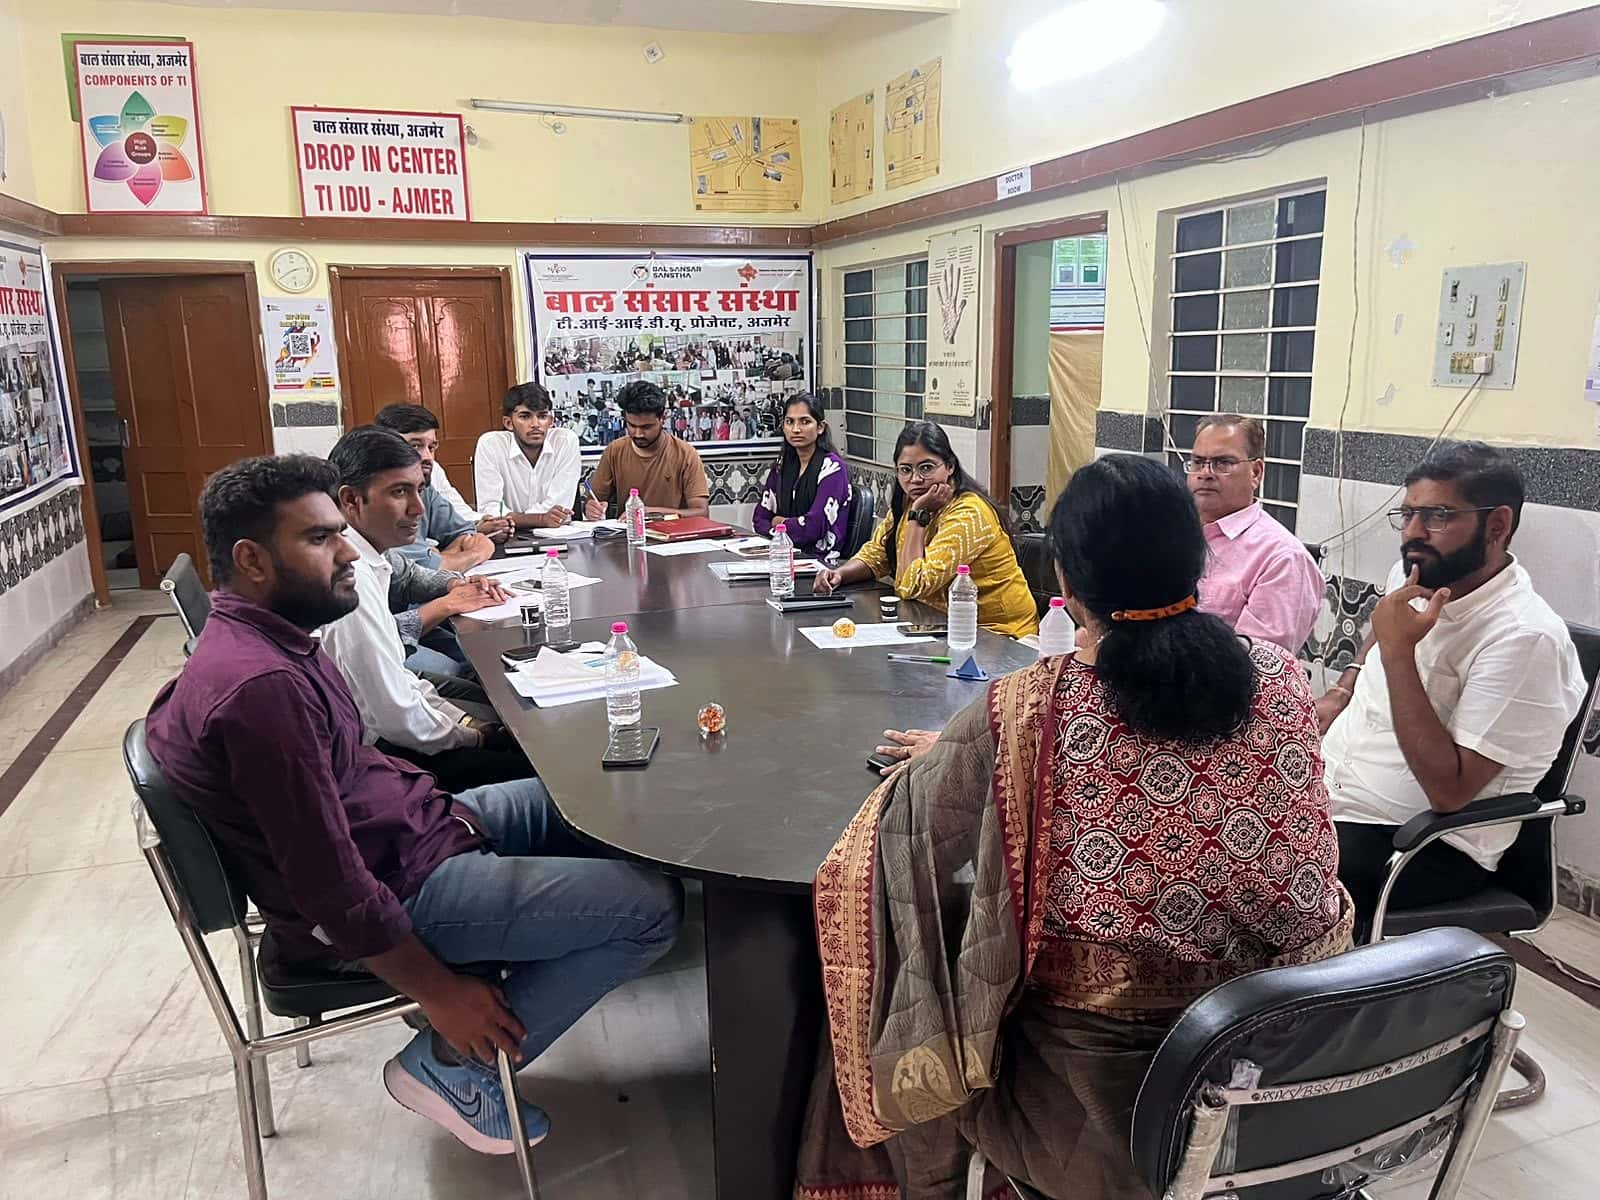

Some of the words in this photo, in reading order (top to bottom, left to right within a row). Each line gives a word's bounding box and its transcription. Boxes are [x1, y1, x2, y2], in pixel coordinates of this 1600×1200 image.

[80, 53, 99, 66] बाल
[101, 49, 125, 66] संसार
[127, 50, 154, 68] संस्था,
[156, 51, 187, 67] अजमेर
[84, 74, 157, 87] COMPONENTS
[160, 75, 174, 87] OF
[176, 75, 187, 86] TI
[312, 119, 337, 134] बाल
[339, 117, 368, 136] संसार
[371, 119, 404, 139] संस्था,
[407, 122, 444, 138] अजमेर
[303, 143, 355, 172] DROP
[362, 145, 381, 172] IN
[387, 146, 458, 175] CENTER
[314, 184, 333, 212] TI
[338, 185, 372, 213] IDU
[392, 187, 455, 215] AJMER
[652, 265, 668, 273] BAL
[669, 265, 702, 273] SANSAR
[543, 291, 617, 313] बाल
[622, 282, 711, 313] संसार
[716, 282, 800, 312] संस्था
[747, 314, 791, 328] अजमेर
